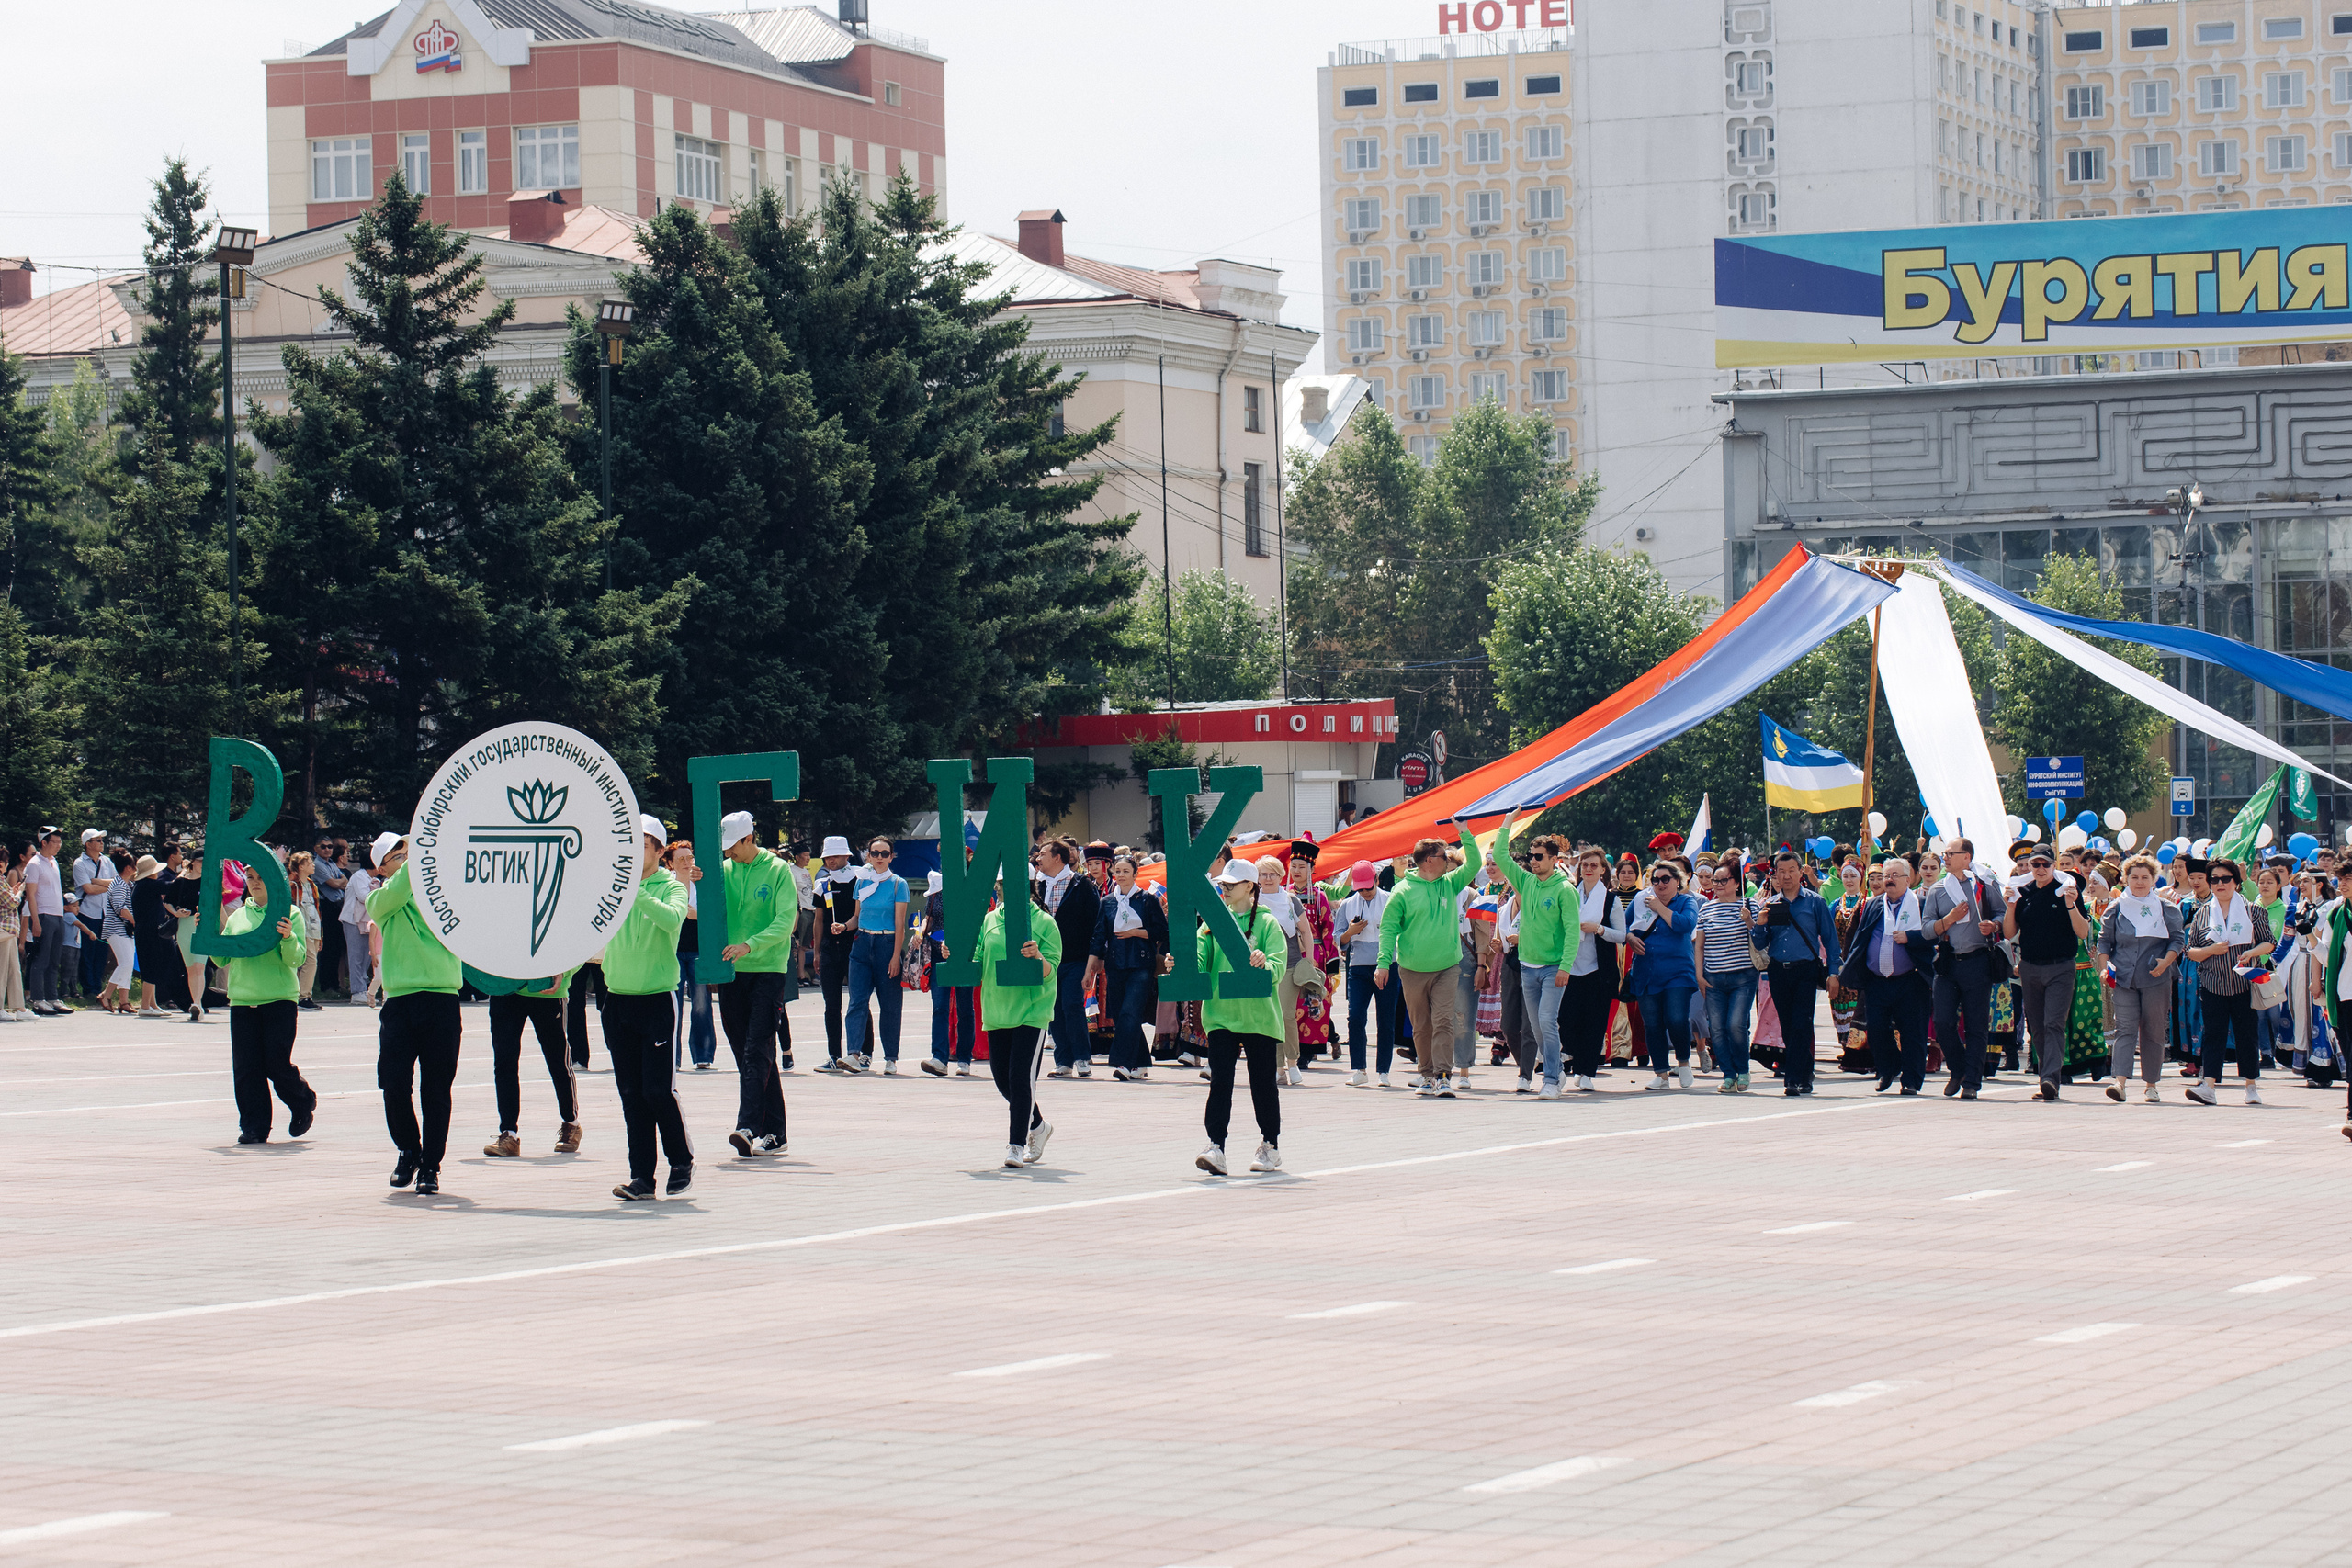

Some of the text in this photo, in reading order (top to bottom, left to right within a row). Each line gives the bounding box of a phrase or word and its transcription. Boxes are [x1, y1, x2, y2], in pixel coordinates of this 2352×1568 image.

[1439, 0, 1574, 35] HOTE
[1882, 243, 2349, 344] Бурятия
[1401, 752, 1428, 763] KARAOKE
[2028, 779, 2084, 788] ИНФОКОММУНИКАЦИЙ
[2029, 772, 2057, 780] БУРЯТСКИЙ
[191, 737, 291, 957] В
[416, 735, 633, 935] Восточно-Сибирский государственный институт культуры
[465, 850, 530, 884] ВСГИК
[687, 750, 800, 985] Г
[927, 757, 1043, 987] И
[1148, 765, 1272, 1002] К
